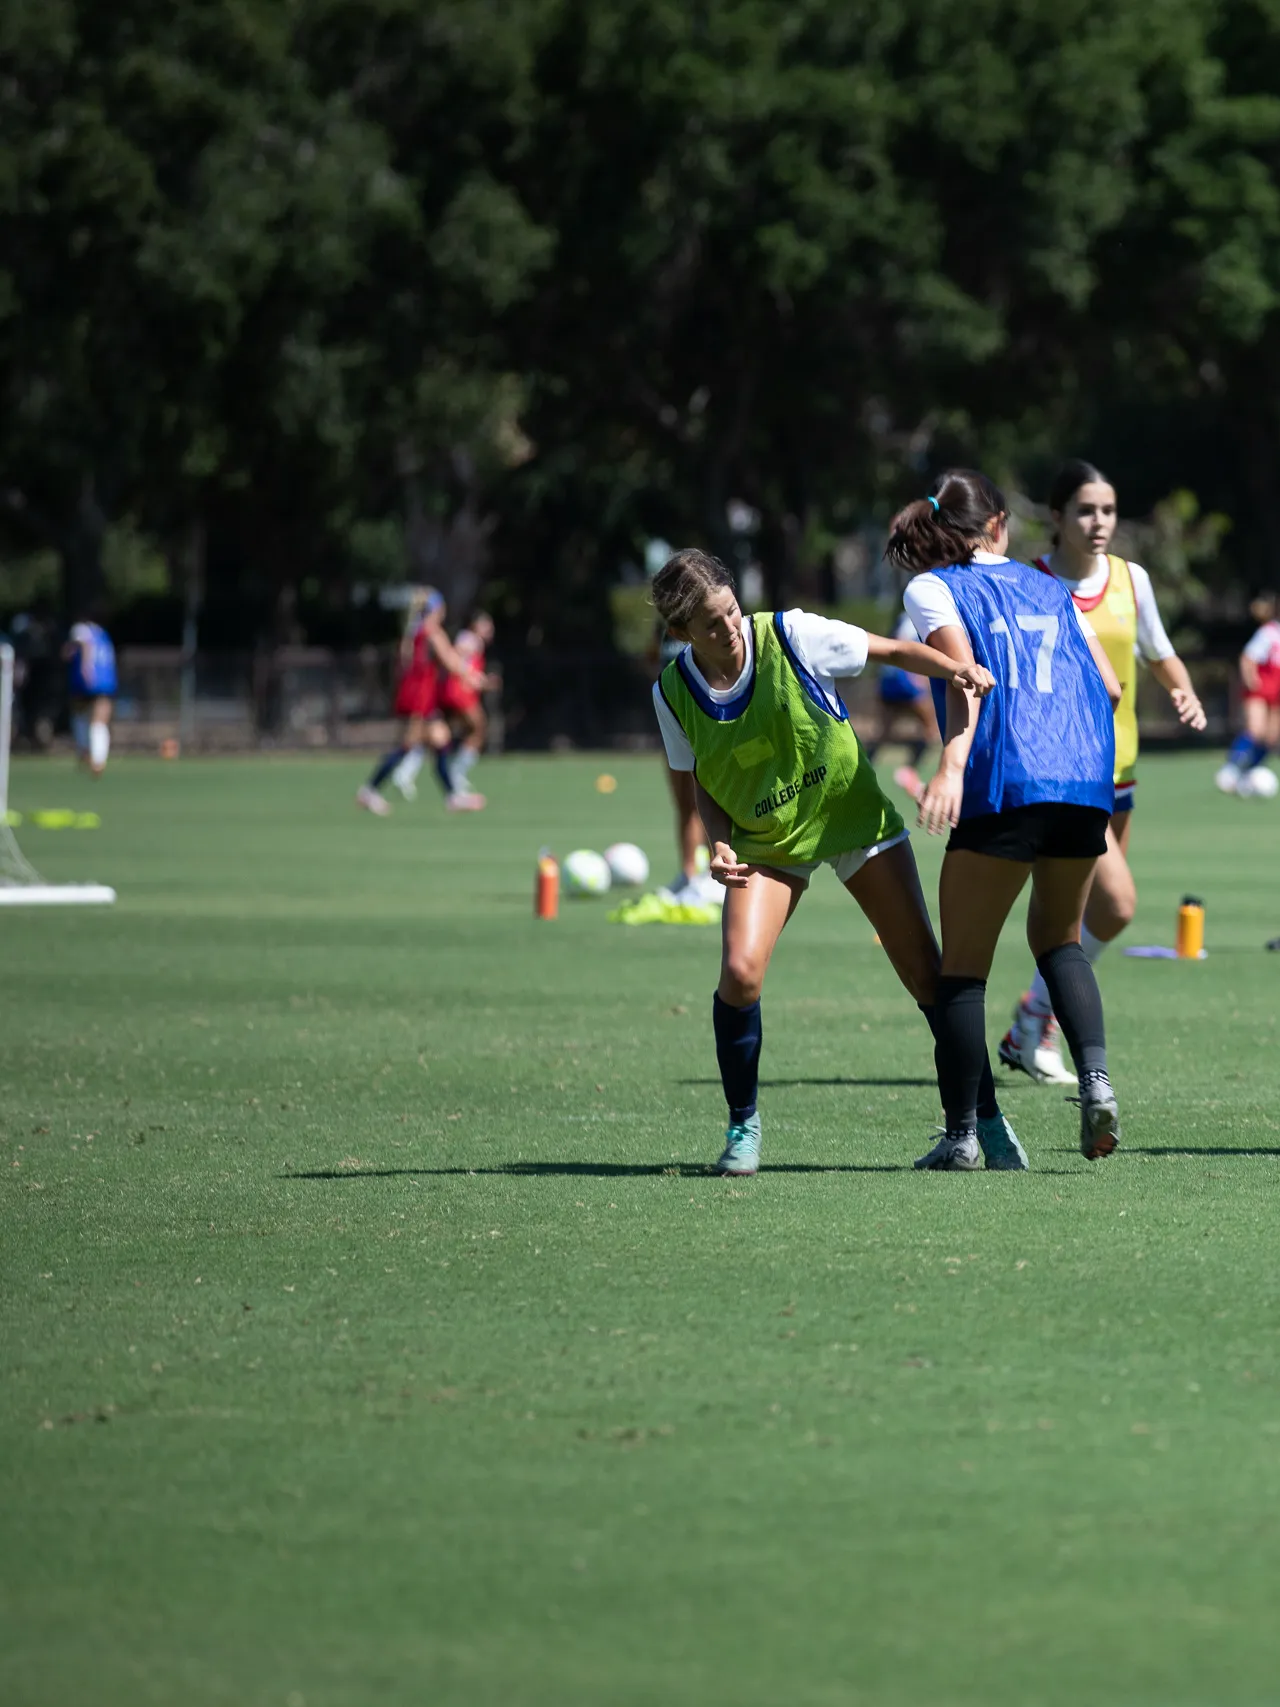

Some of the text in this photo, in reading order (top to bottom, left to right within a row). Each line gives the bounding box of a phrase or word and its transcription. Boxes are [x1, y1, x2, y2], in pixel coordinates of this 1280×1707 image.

[989, 614, 1060, 694] 17
[755, 764, 827, 818] COLLEGE CUP
